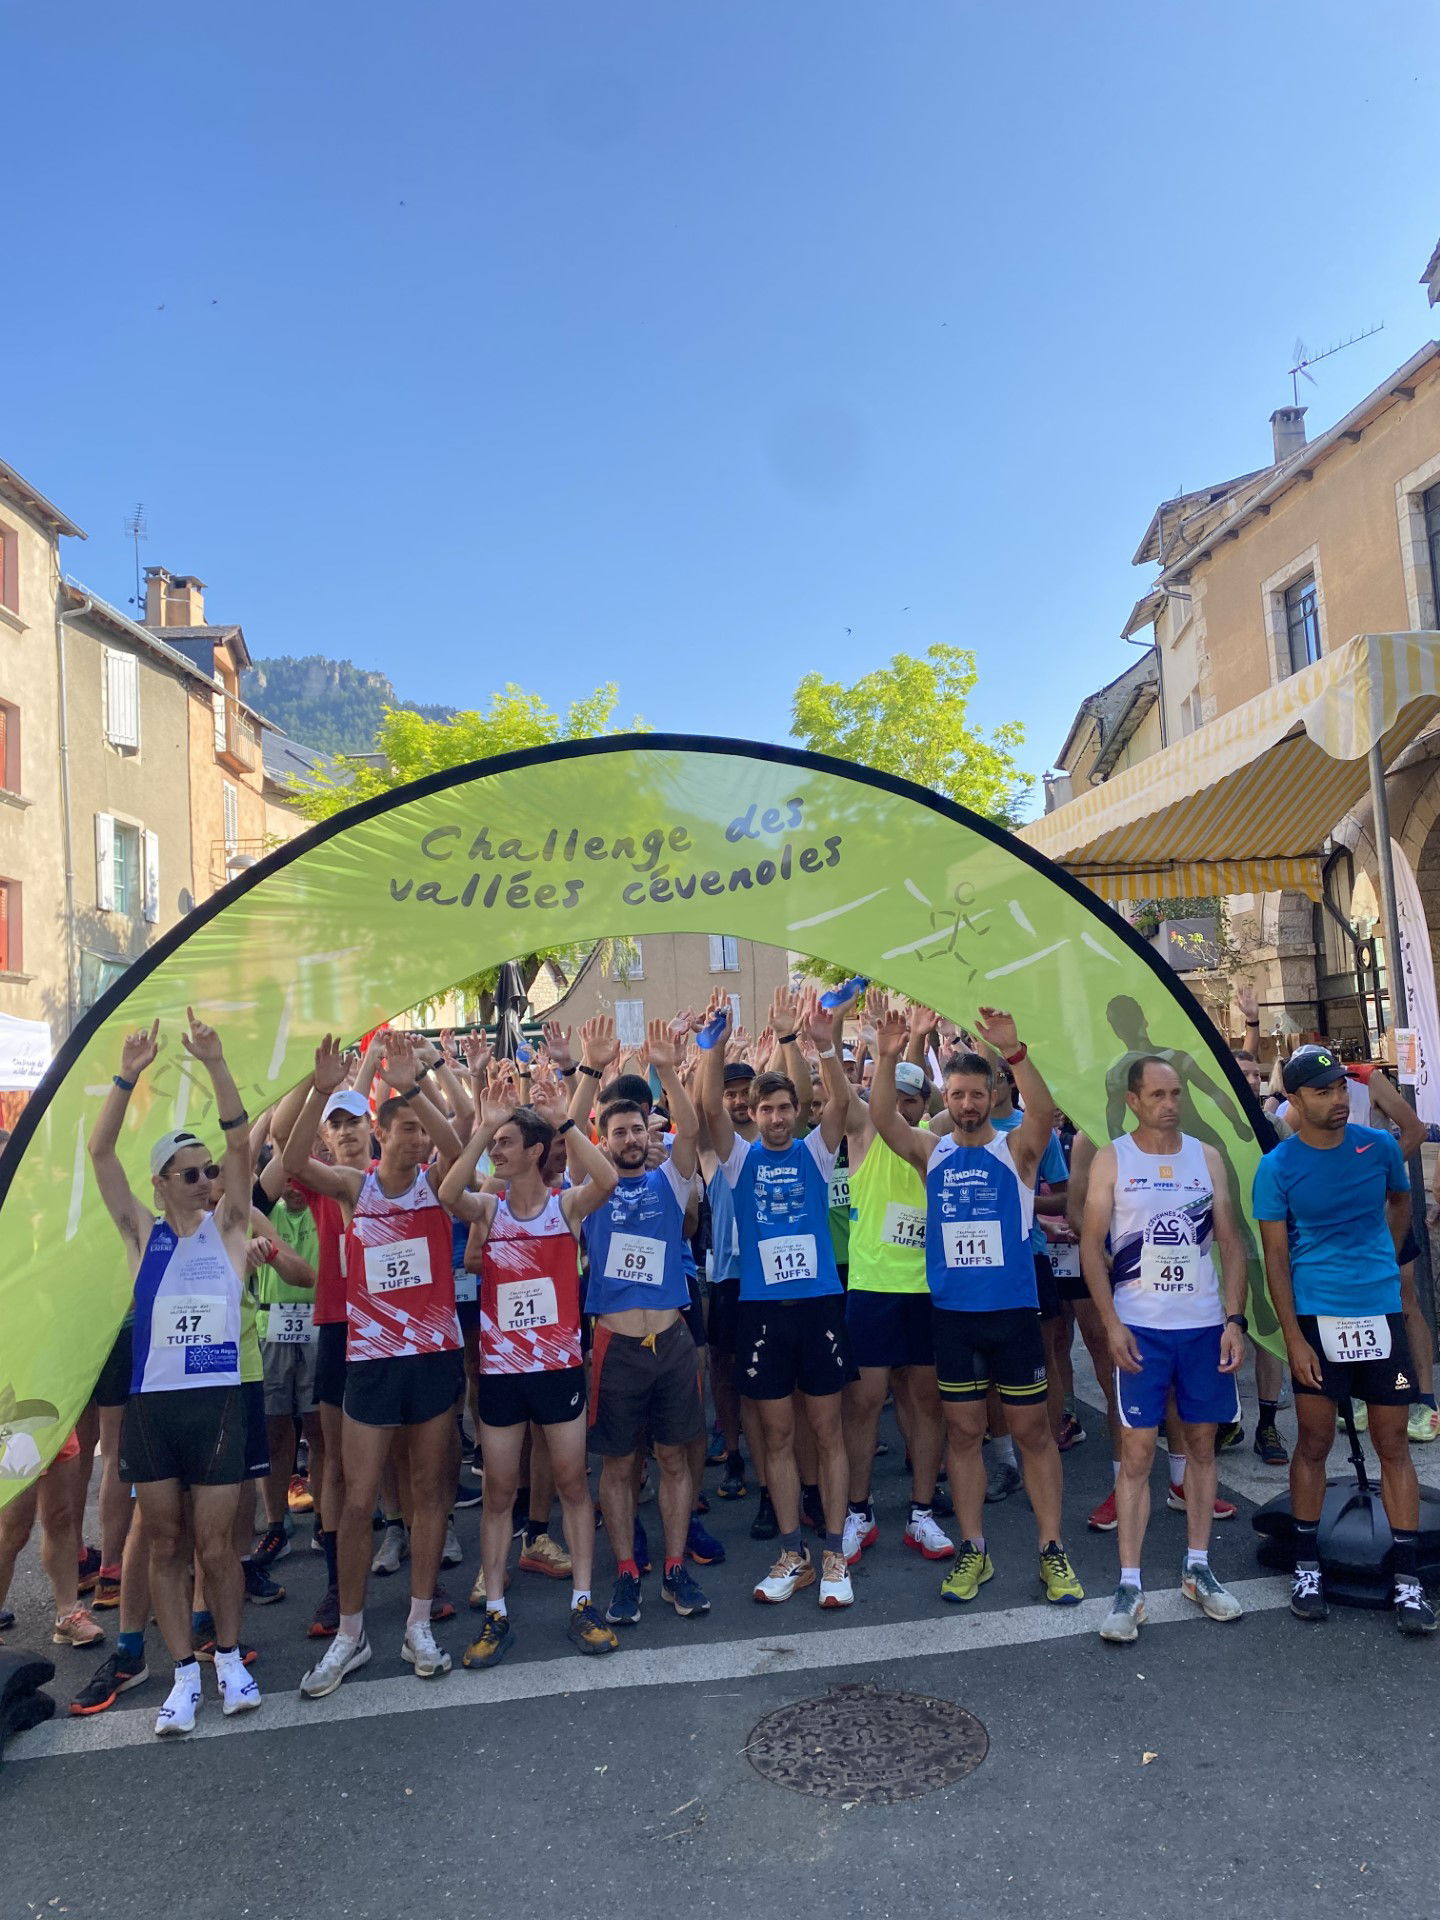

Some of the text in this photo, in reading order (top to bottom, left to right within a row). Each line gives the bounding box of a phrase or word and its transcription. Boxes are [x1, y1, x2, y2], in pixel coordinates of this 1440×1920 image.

[420, 797, 804, 873] Challenge des
[390, 836, 842, 909] vallées cévenoles
[833, 1183, 850, 1197] 10
[832, 1197, 850, 1205] TUF
[896, 1221, 926, 1239] 114
[892, 1235, 926, 1249] TUFF'S
[956, 1239, 986, 1255] 111
[624, 1253, 646, 1270] 69
[774, 1252, 806, 1270] 112
[954, 1257, 992, 1265] TUFF'S
[387, 1260, 410, 1278] 52
[616, 1269, 653, 1281] TUFF'S
[775, 1268, 811, 1281] TUFF'S
[1054, 1268, 1072, 1276] FF'S
[1160, 1265, 1184, 1281] 49
[380, 1275, 421, 1290] TUFF'S
[1153, 1283, 1194, 1292] TUFF'S
[514, 1299, 535, 1317] 21
[176, 1315, 202, 1332] 47
[284, 1319, 303, 1332] 33
[508, 1315, 547, 1328] TUFF'S
[167, 1334, 212, 1345] TUFF'S
[277, 1333, 311, 1342] TUFF'S
[1338, 1329, 1376, 1348] 113
[1337, 1348, 1383, 1360] TUFF'S
